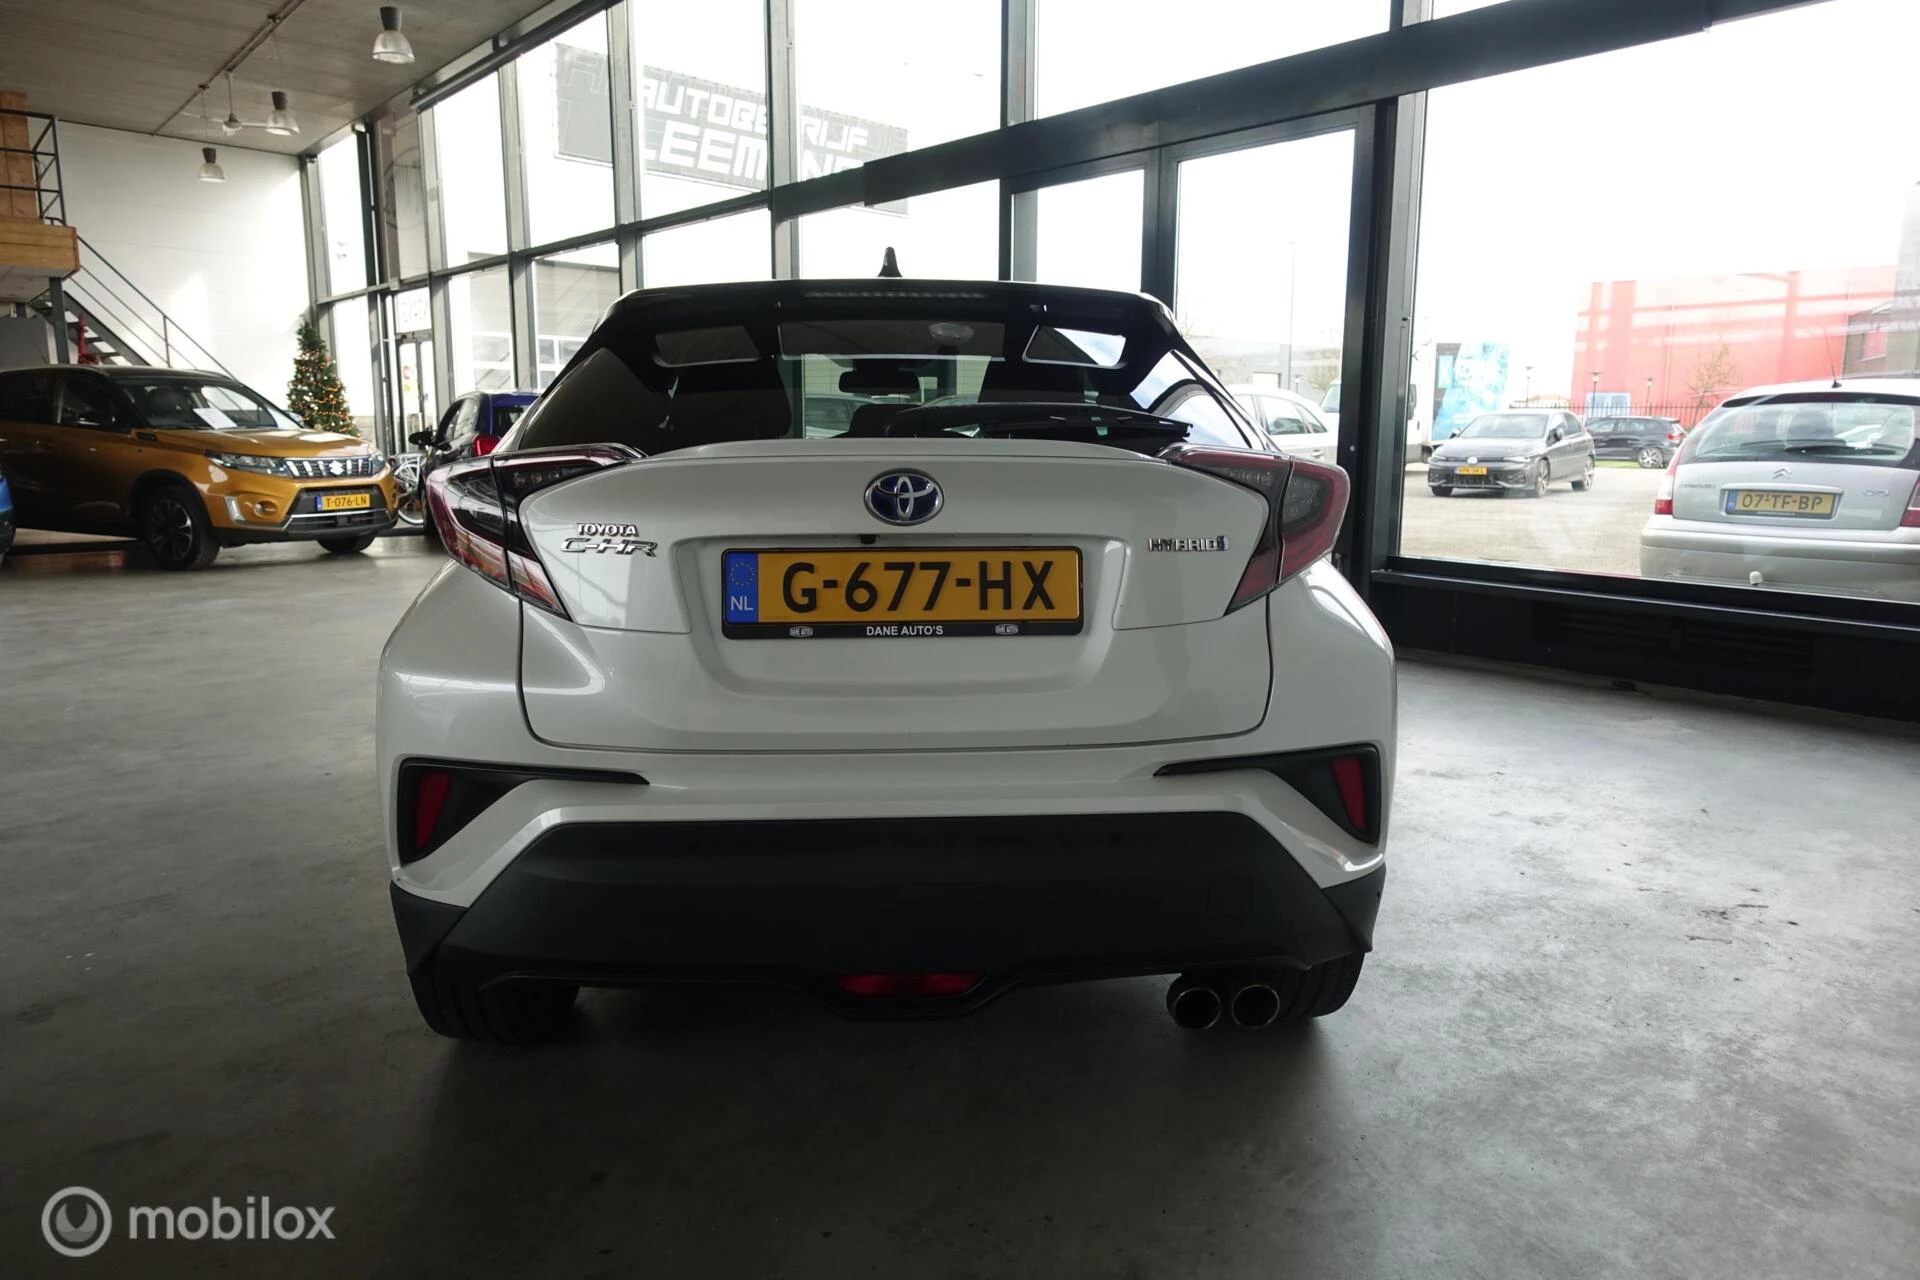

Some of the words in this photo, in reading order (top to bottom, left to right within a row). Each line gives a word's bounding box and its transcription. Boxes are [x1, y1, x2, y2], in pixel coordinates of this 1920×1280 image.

[326, 495, 367, 508] T-076-LN
[1742, 493, 1823, 511] 07-TF-BP
[577, 523, 639, 537] TOYOTA
[561, 538, 657, 557] C-HR
[1148, 537, 1218, 551] HYBRID
[782, 560, 1055, 613] G-677-HX
[730, 595, 754, 611] NL
[866, 625, 898, 636] DANE
[901, 625, 944, 636] AUTO'S
